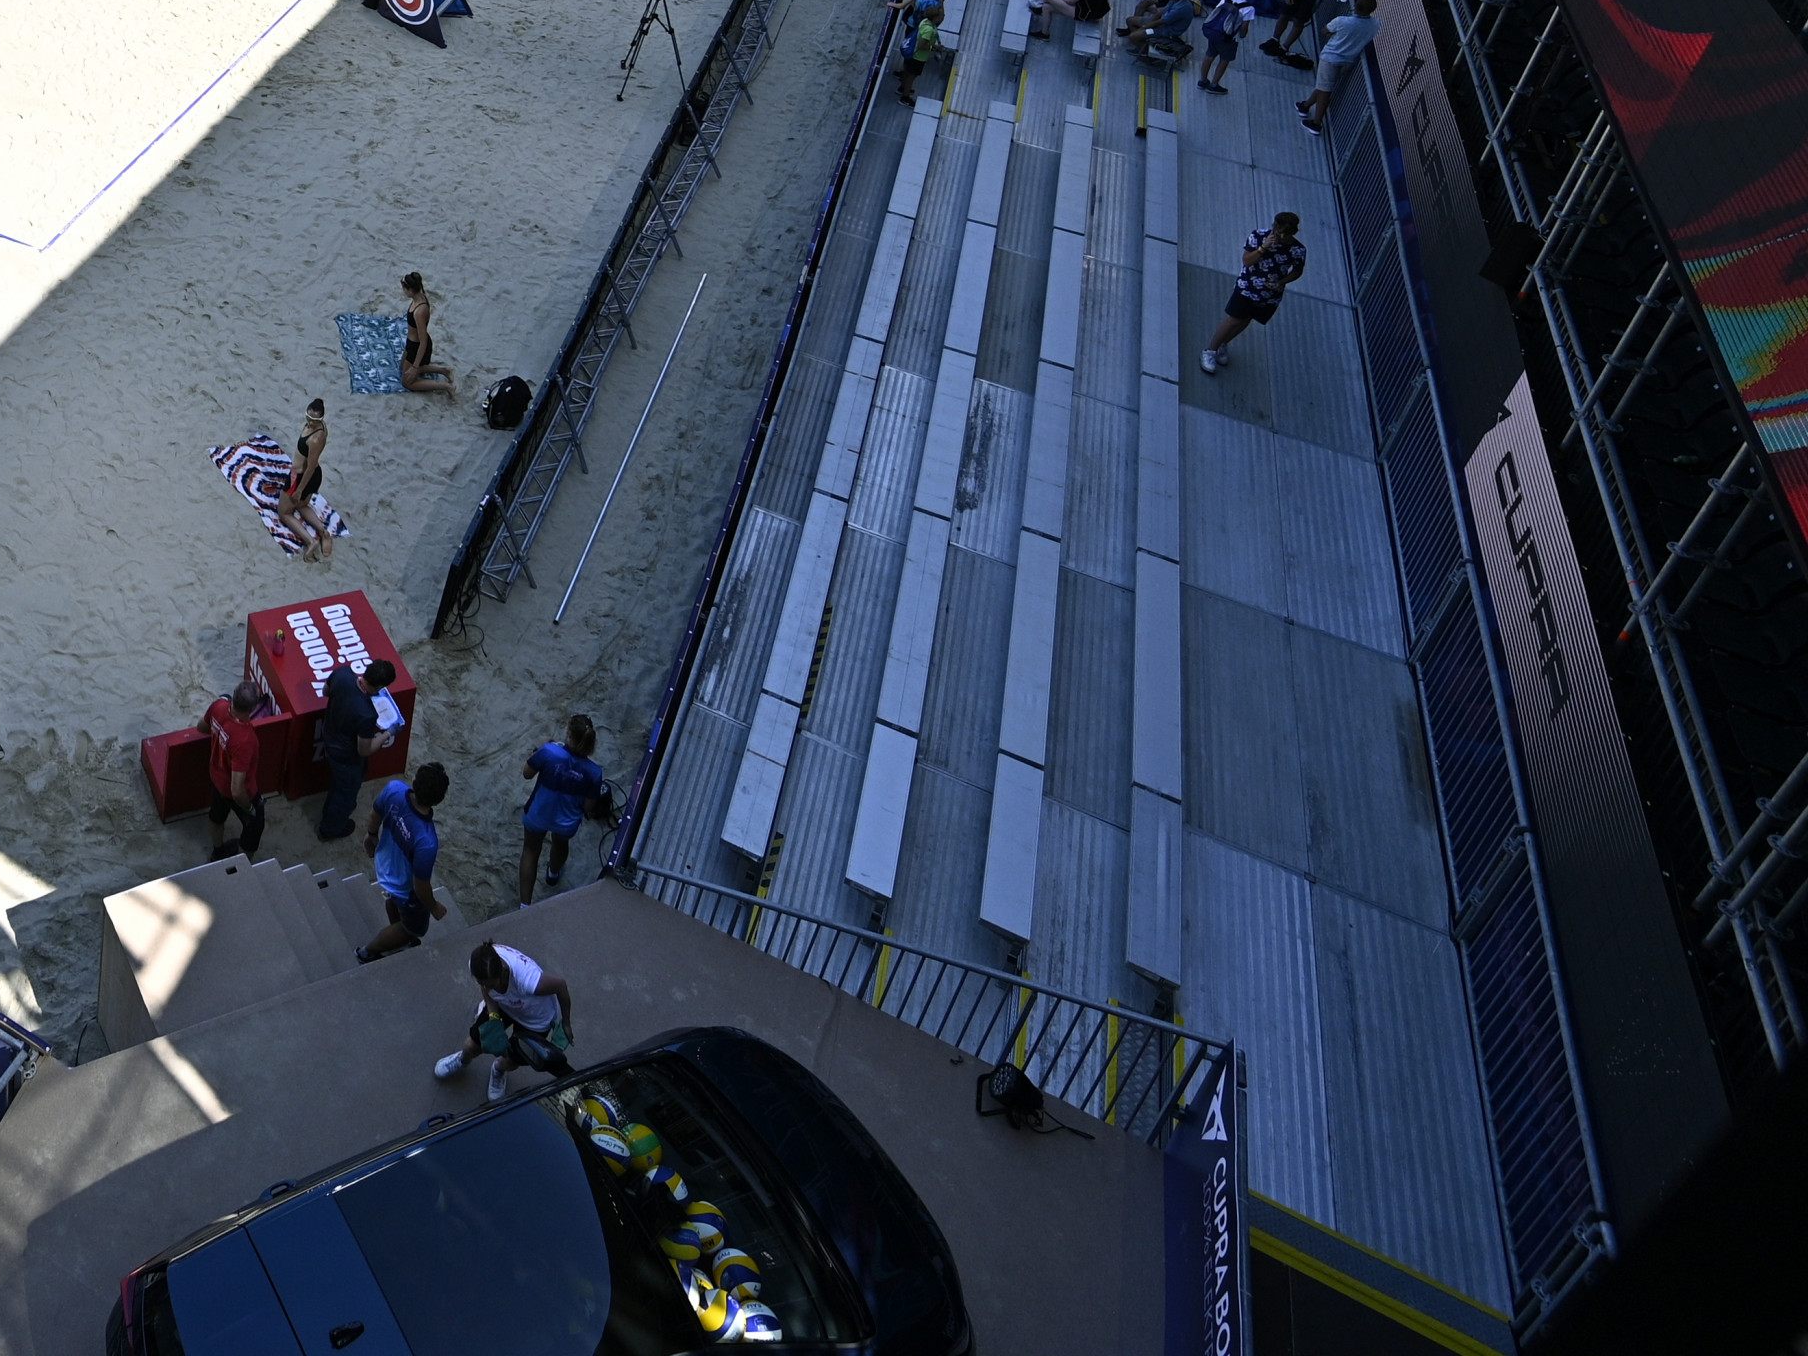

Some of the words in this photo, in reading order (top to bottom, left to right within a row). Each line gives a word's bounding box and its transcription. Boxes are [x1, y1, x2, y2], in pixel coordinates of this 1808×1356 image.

[1495, 451, 1571, 721] CUPRA
[320, 603, 374, 675] eitung
[1202, 1173, 1213, 1255] 100%
[1213, 1157, 1229, 1296] CUPRA
[1215, 1291, 1231, 1356] BO
